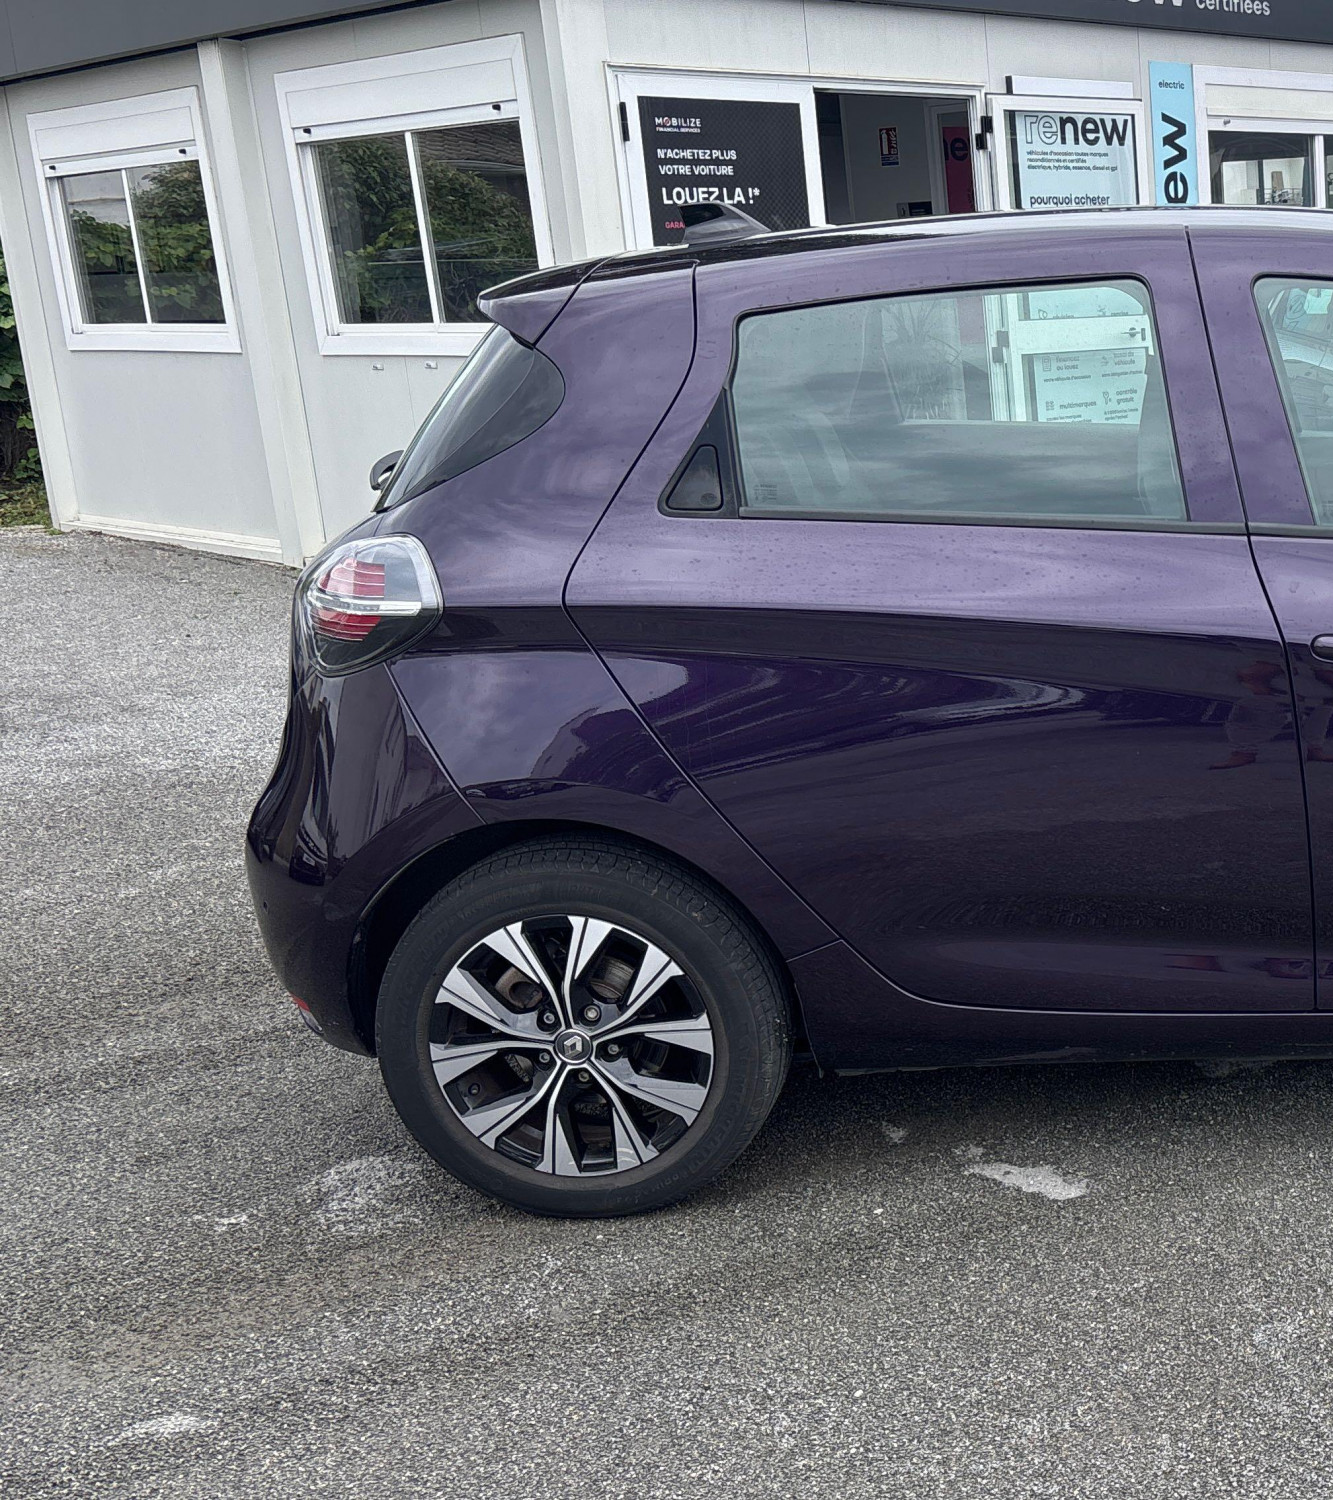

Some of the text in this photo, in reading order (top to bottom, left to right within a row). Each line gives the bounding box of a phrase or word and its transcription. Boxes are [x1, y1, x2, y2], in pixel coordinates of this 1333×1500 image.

[1158, 79, 1185, 90] electric
[655, 116, 702, 127] MOBILIZE
[1024, 114, 1129, 147] renew
[656, 148, 738, 160] N'ACHETEZ PLUS
[658, 164, 735, 176] VOTRE VOITURE
[723, 187, 746, 204] LA
[1030, 193, 1110, 207] pourquoi acheter
